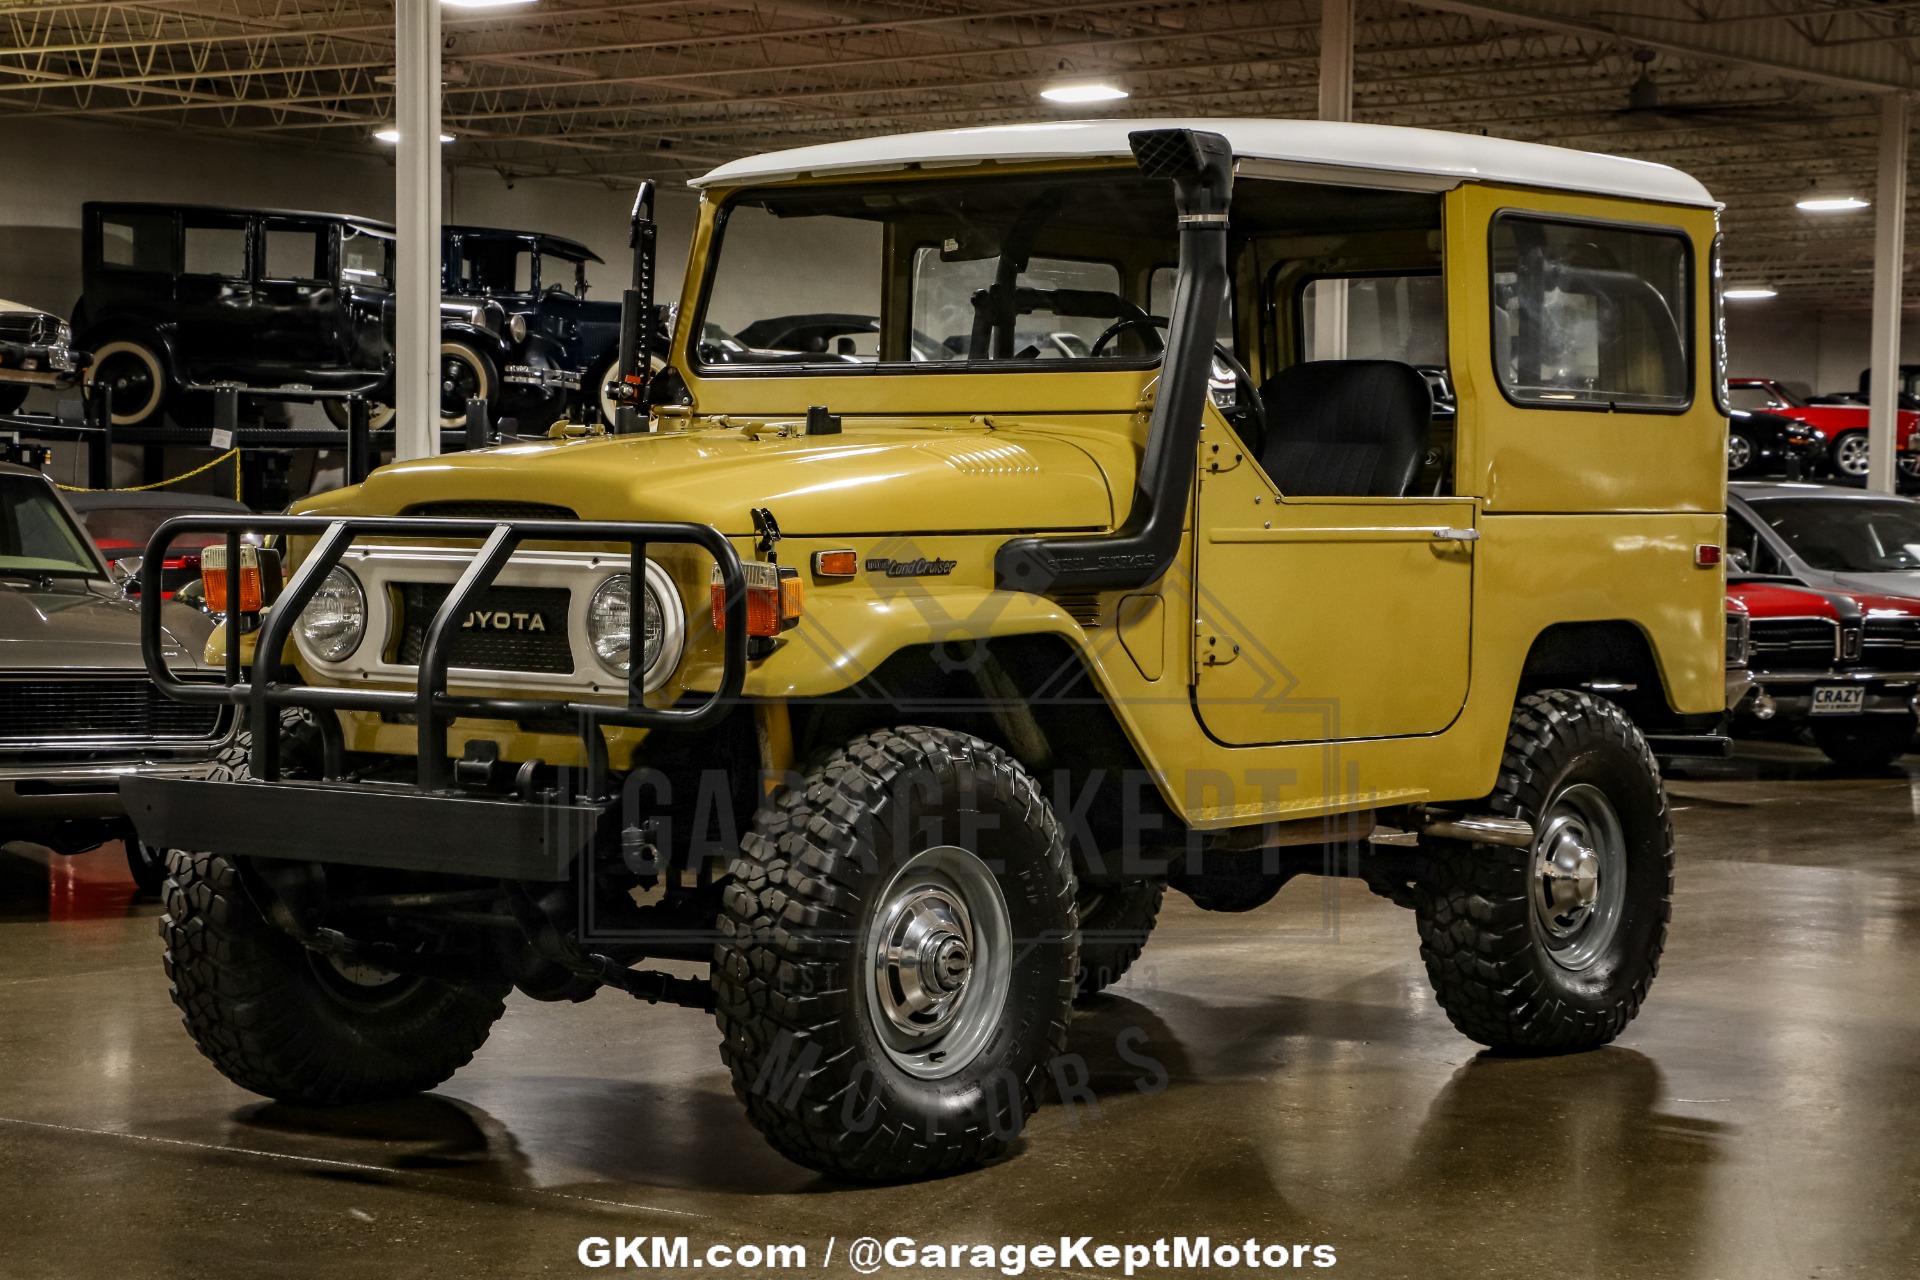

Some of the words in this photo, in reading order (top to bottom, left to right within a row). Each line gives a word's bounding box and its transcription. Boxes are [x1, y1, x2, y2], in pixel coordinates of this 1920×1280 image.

[915, 557, 957, 575] Cruiser
[462, 610, 546, 632] YOTA
[1815, 689, 1863, 703] CRAZY
